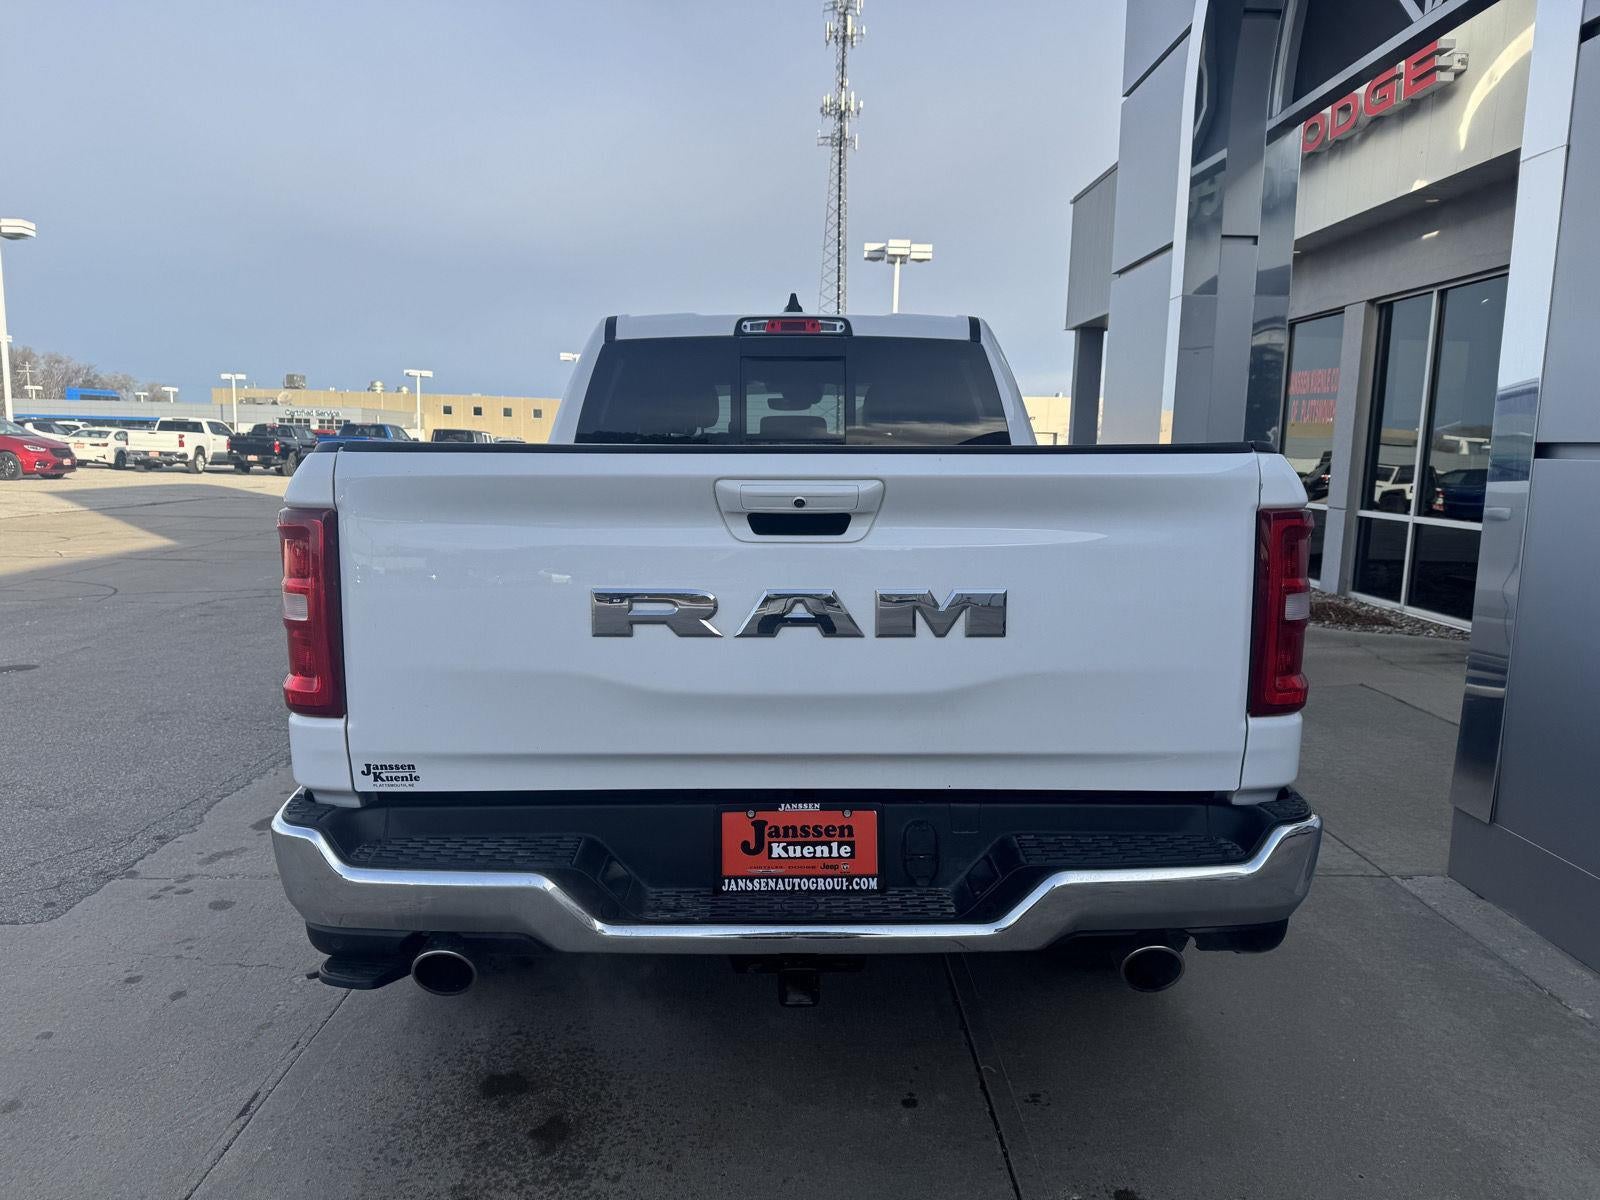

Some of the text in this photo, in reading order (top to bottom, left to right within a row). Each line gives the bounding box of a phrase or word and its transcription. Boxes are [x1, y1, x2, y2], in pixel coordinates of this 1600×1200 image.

[285, 408, 342, 417] Certified Service
[591, 587, 1008, 638] RAM
[361, 763, 416, 776] Janssen
[372, 772, 420, 782] Kuenle
[778, 803, 820, 812] JANSSEN
[741, 820, 855, 856] Janssen
[770, 842, 852, 859] Kuenle
[820, 862, 839, 871] Jeep
